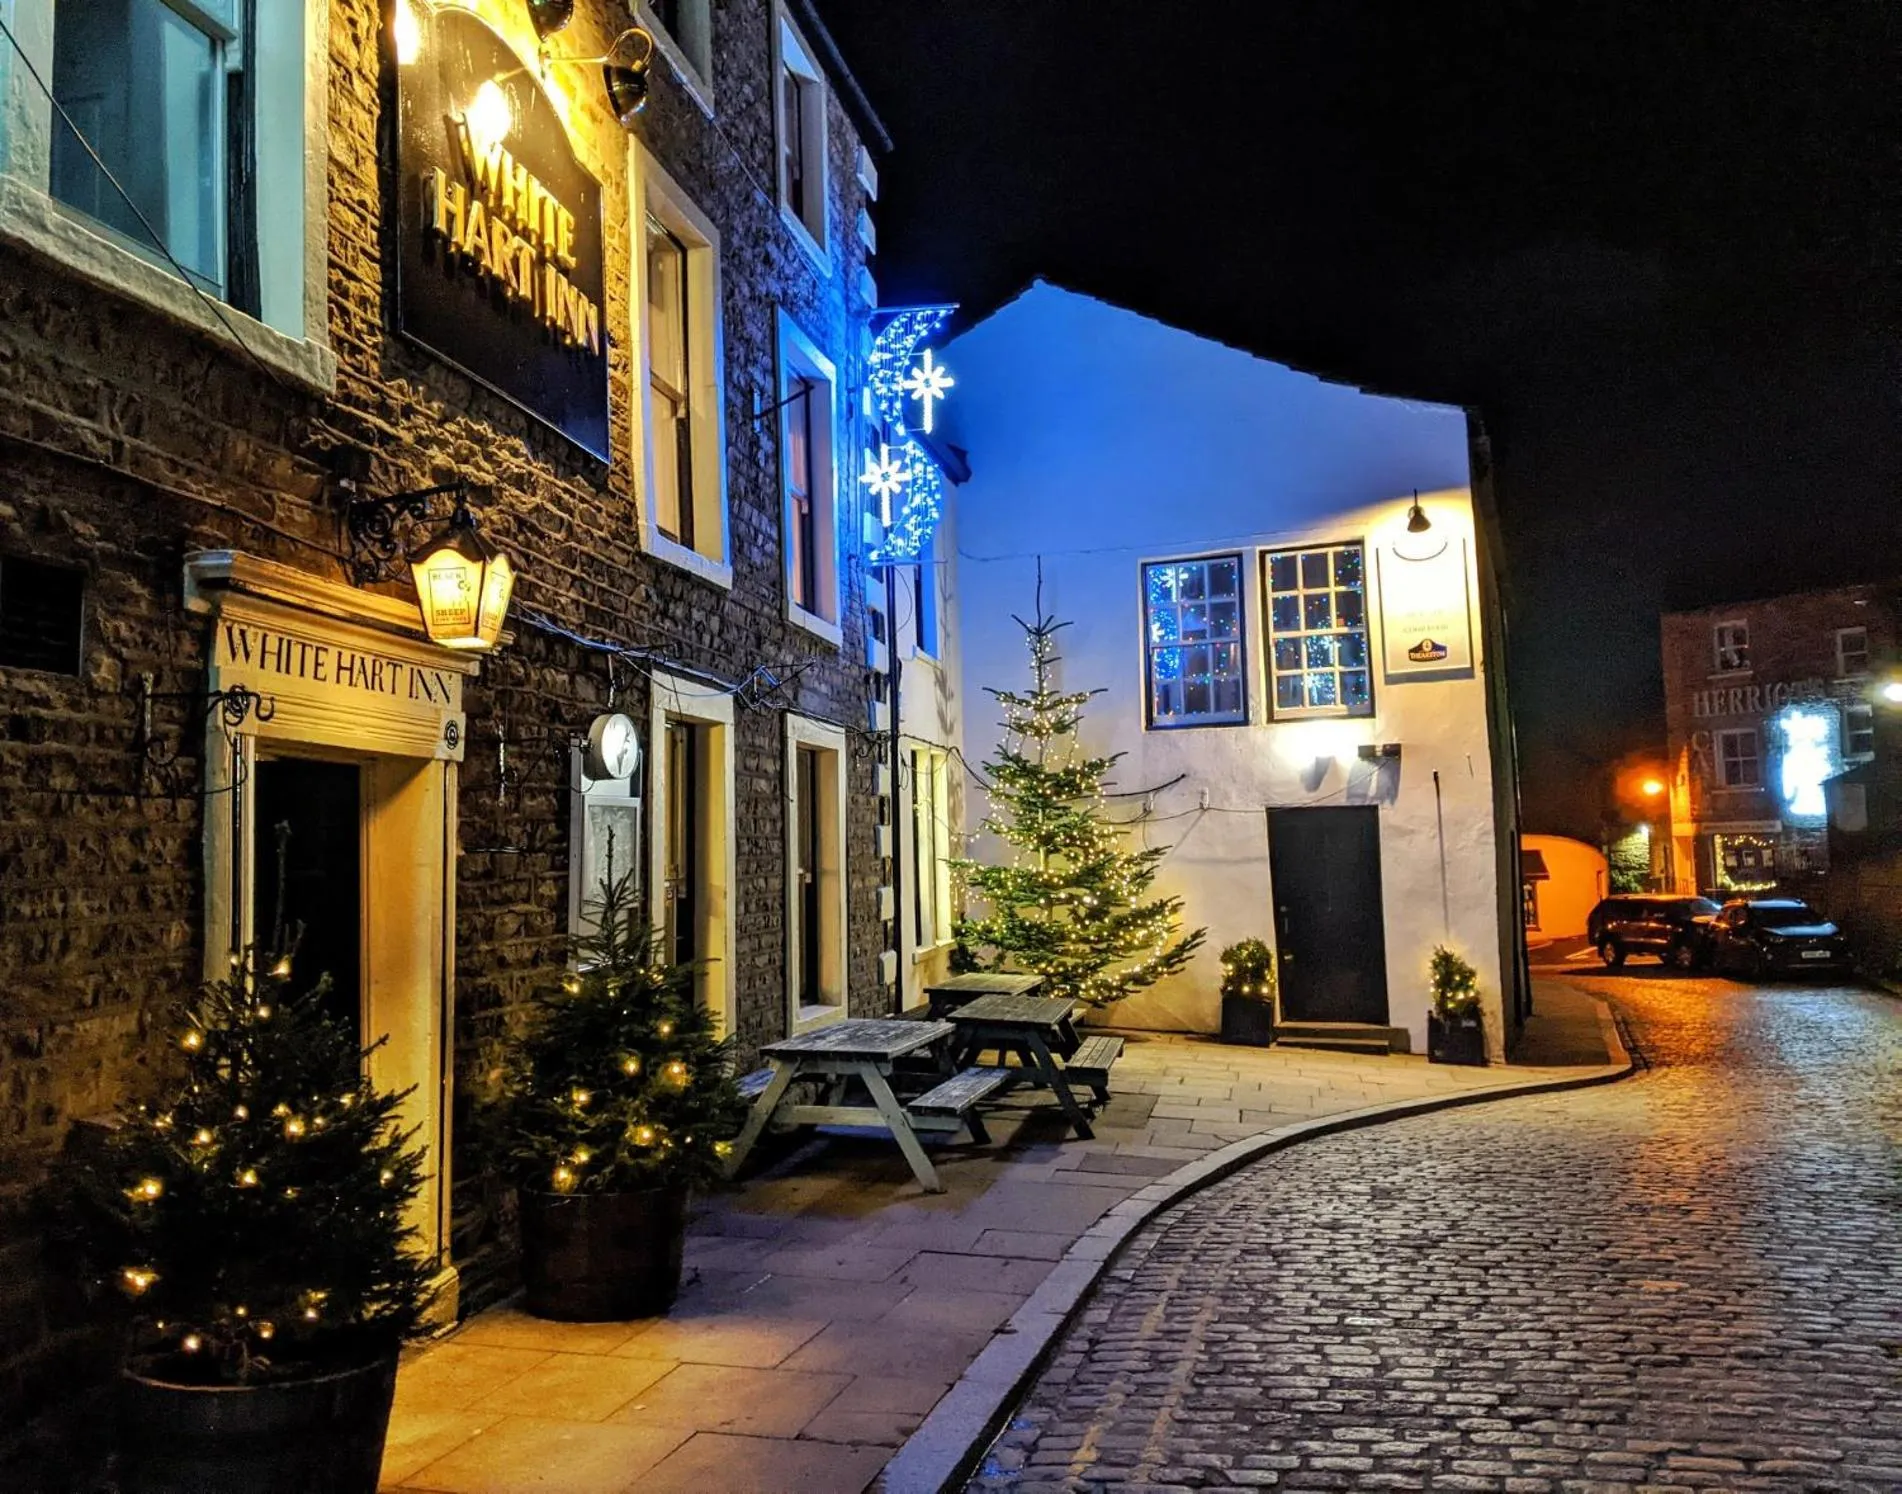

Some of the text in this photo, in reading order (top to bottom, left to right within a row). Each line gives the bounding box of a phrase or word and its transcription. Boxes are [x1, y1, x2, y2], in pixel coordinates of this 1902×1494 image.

[443, 113, 577, 268] WHITE
[433, 167, 600, 356] HART INN
[225, 624, 453, 705] WHITE HART INN
[435, 607, 466, 616] SHEEP
